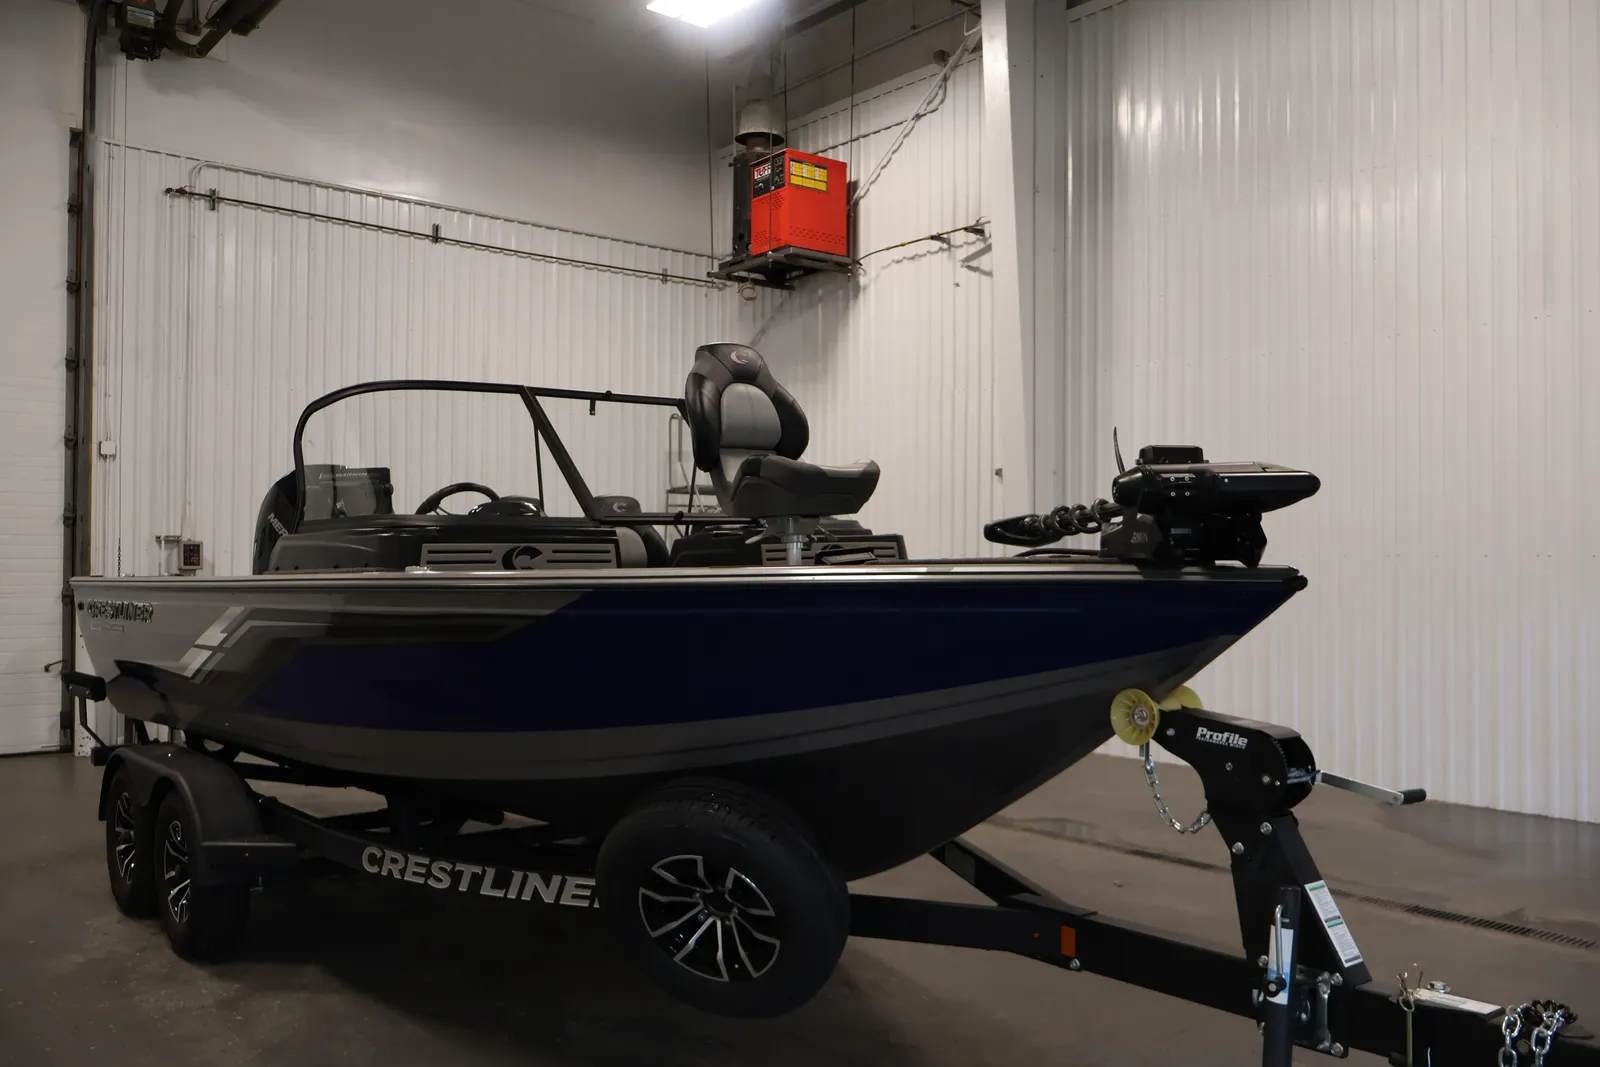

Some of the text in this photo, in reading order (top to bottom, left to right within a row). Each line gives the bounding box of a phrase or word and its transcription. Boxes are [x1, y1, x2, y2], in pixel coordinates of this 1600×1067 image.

[87, 599, 154, 623] CRESTLINER
[1196, 726, 1248, 746] Profile
[361, 845, 600, 909] CRESTLINE
